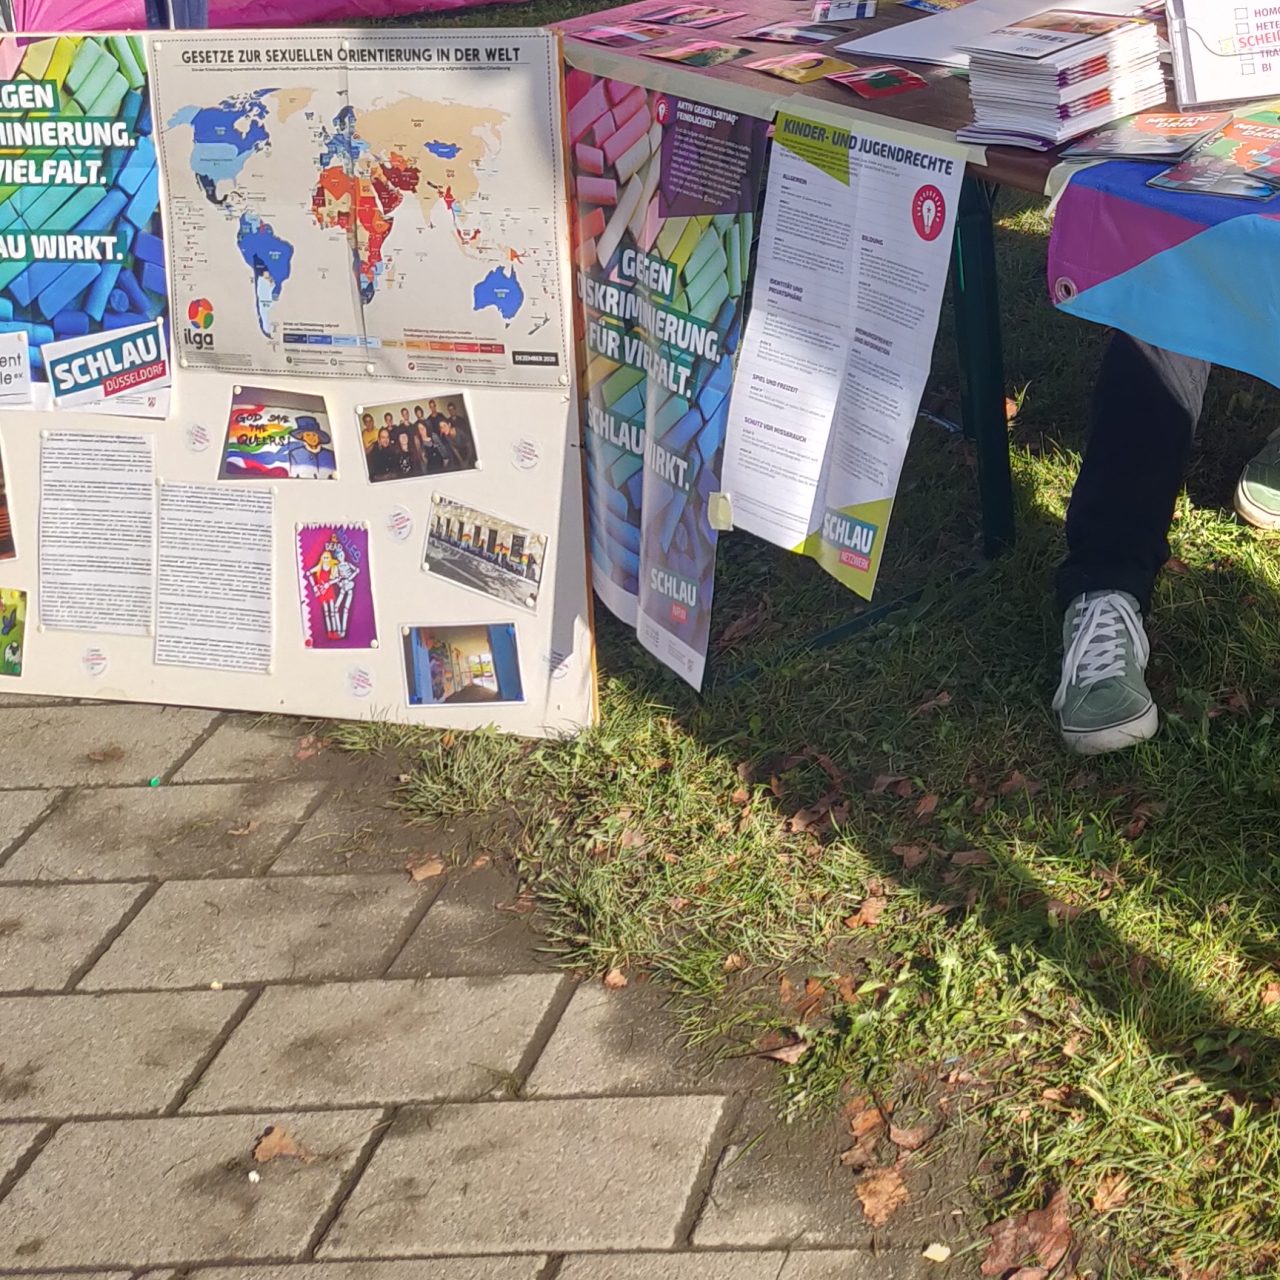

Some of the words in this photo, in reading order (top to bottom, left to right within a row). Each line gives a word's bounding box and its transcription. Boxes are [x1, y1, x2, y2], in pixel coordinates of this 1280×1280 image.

[1026, 32, 1070, 44] FIBEL
[182, 50, 235, 64] GESETZE
[238, 50, 262, 63] ZUR
[266, 49, 334, 62] SEXUELLEN
[337, 48, 433, 62] ORIENTIERUNG
[437, 48, 451, 62] IN
[455, 48, 481, 62] DER
[485, 47, 521, 62] WELT
[1262, 63, 1272, 72] BI
[0, 84, 55, 109] GEN
[1145, 114, 1218, 126] MITTEN-
[1156, 121, 1196, 129] DRIN
[784, 119, 830, 142] KINDER-
[832, 131, 858, 150] UND
[858, 138, 954, 176] JUGENDRECHTE
[31, 234, 124, 260] WIRKT.
[622, 248, 673, 296] GEGEN
[184, 328, 214, 350] ilga
[54, 333, 158, 391] SCHLAU
[588, 319, 621, 360] FÜR
[623, 335, 692, 399] VIELFALT.
[106, 363, 165, 392] DÜSSELDORF
[235, 413, 263, 424] GOD
[249, 423, 269, 433] THE
[588, 399, 645, 456] SCHLAU
[237, 433, 291, 447] QUEERS!
[822, 511, 875, 554] SCHLAU
[650, 567, 697, 608] SCHLAU
